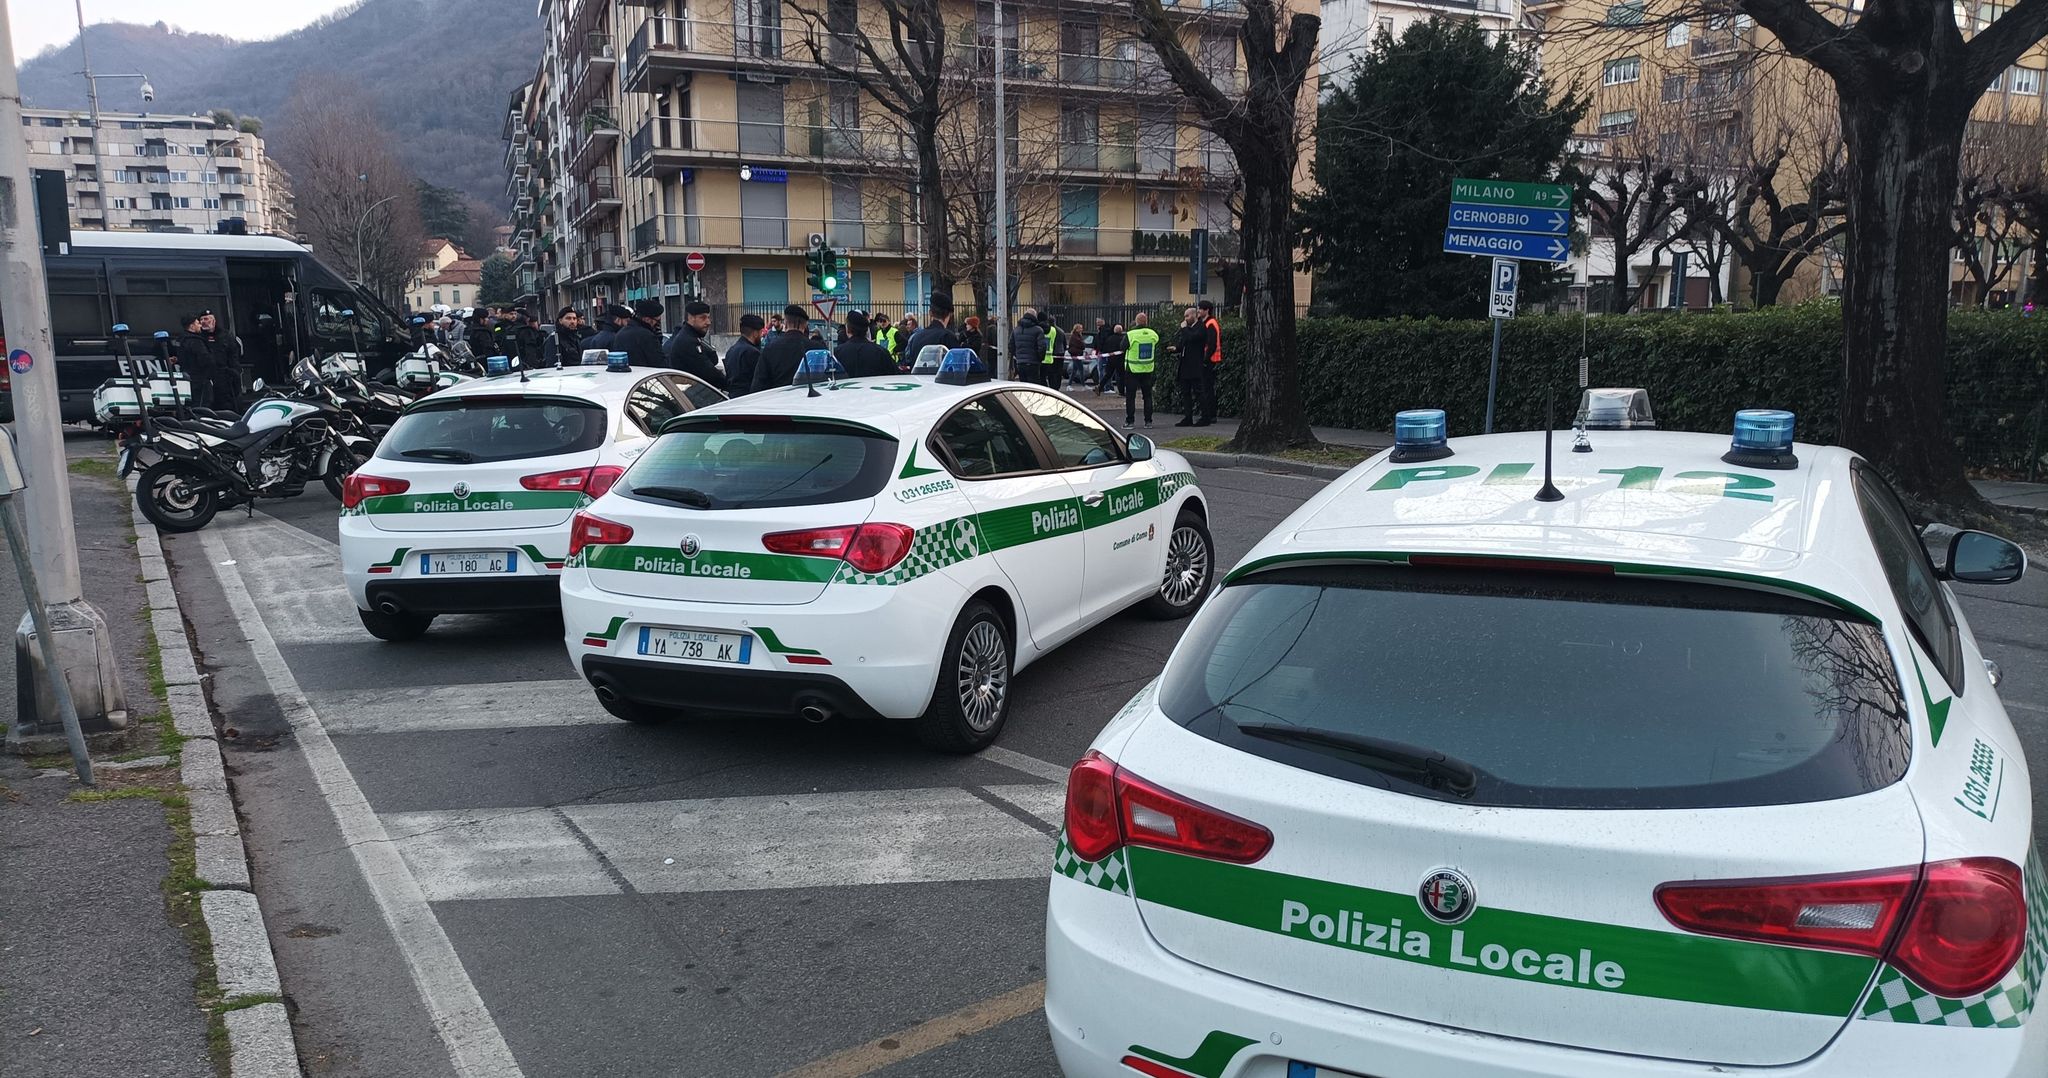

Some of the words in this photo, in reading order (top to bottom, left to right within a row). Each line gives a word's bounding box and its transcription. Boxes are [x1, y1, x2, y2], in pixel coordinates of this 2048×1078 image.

[1455, 184, 1515, 200] MILANO
[1535, 191, 1547, 201] A9
[1453, 210, 1530, 226] CERNOBBIO
[1448, 233, 1523, 251] MENAGGIO
[1499, 266, 1512, 290] P
[1494, 293, 1513, 307] BUS
[902, 480, 954, 500] 031265555
[414, 500, 459, 512] Polizia
[464, 499, 514, 511] Locale
[1032, 503, 1078, 535] Polizia
[1108, 487, 1144, 516] Locale
[435, 561, 446, 572] YA
[460, 560, 478, 572] 180
[634, 556, 685, 574] Polizia
[691, 560, 751, 578] Locale
[669, 631, 690, 640] POLIZIA
[694, 634, 718, 643] LOCALE
[654, 638, 667, 655] YA
[681, 641, 704, 657] 738
[717, 644, 733, 660] AK
[1443, 873, 1468, 900] ROMEO
[1281, 899, 1431, 959] Polizia
[1450, 929, 1626, 989] Locale
